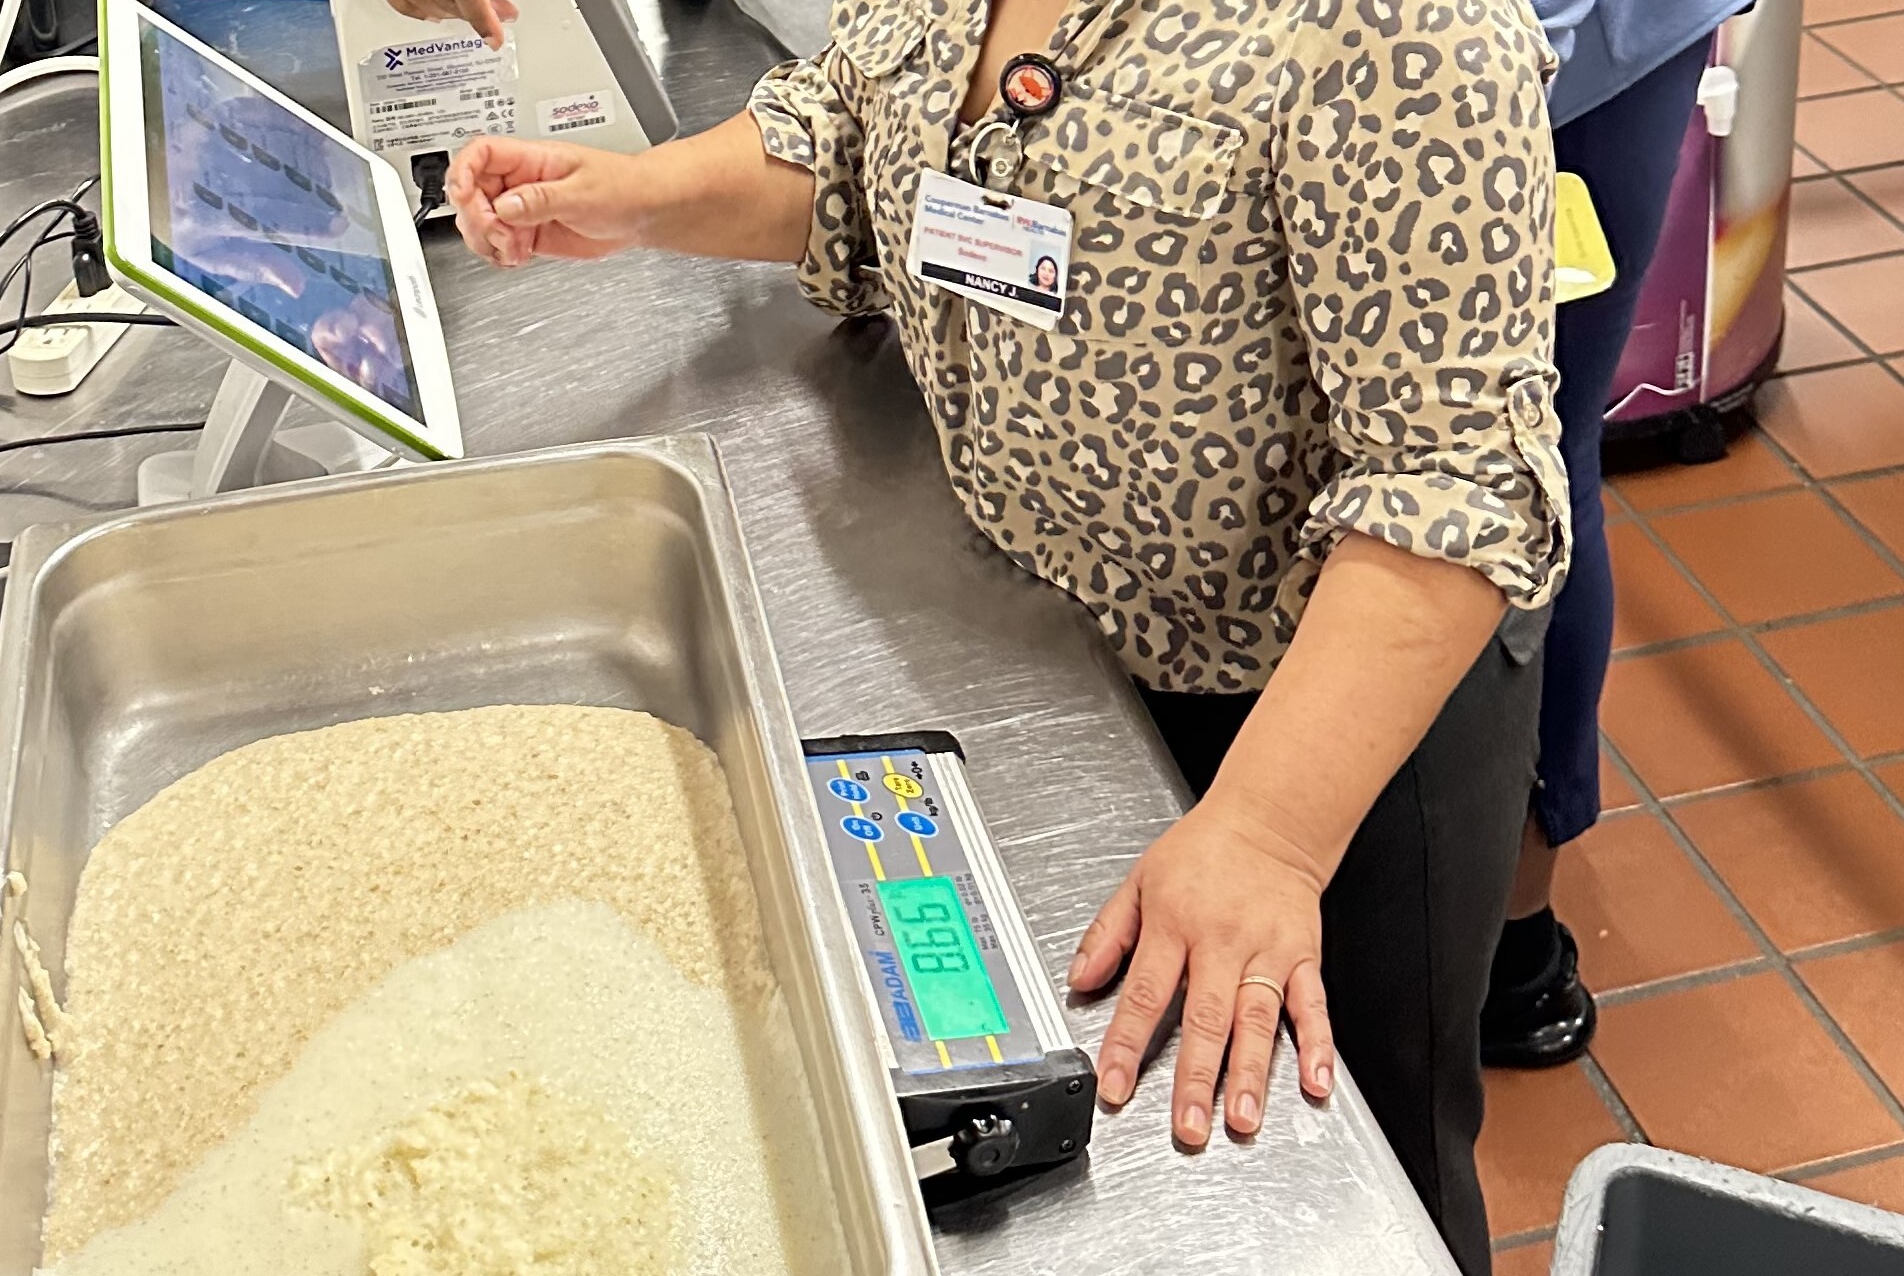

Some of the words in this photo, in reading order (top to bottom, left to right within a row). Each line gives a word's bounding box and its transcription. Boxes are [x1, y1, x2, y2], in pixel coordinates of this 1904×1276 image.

[406, 39, 487, 57] MedVantag
[965, 273, 1006, 294] NANCY
[875, 951, 908, 1000] ADAM
